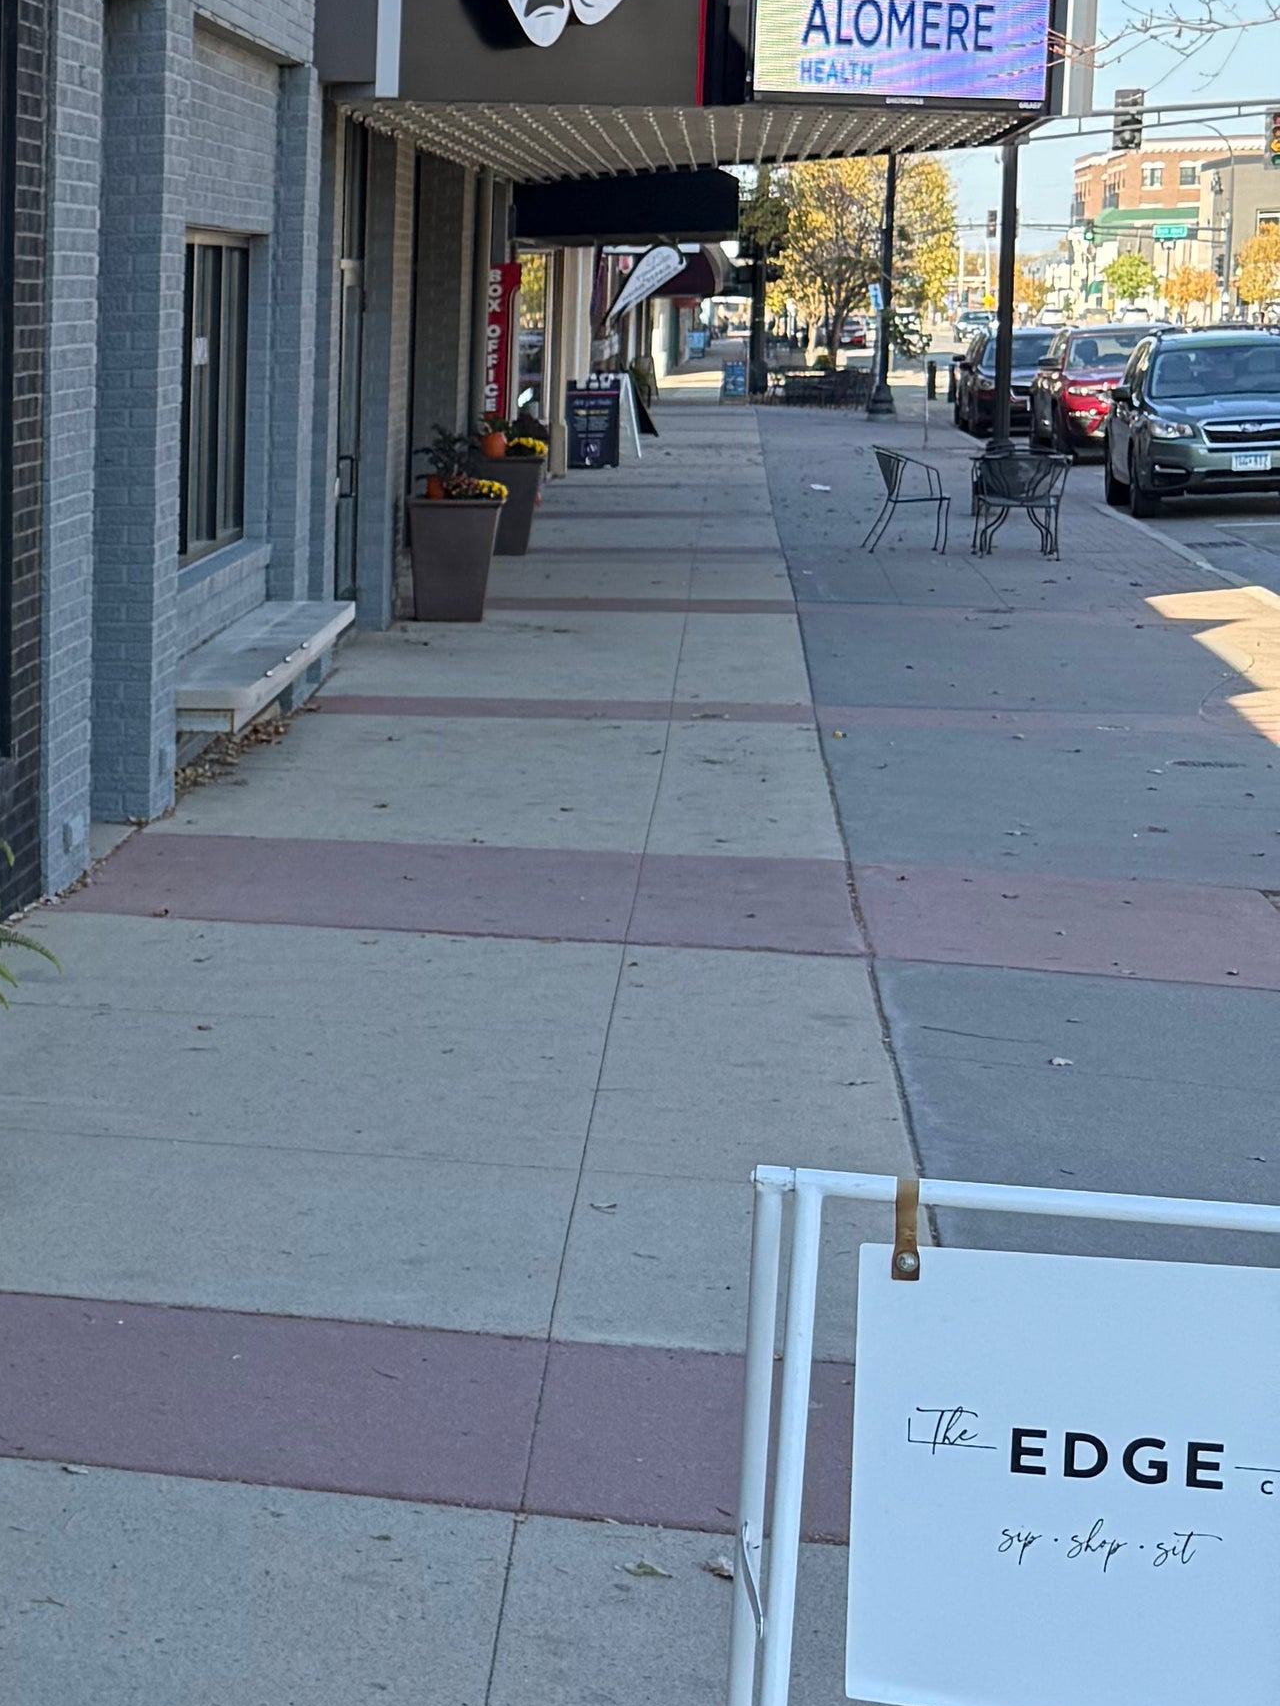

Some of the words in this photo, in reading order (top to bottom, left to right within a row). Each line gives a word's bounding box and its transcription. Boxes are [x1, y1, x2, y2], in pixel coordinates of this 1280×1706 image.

[799, 57, 873, 85] HEALTH
[488, 269, 502, 313] BOX
[485, 324, 501, 412] OFFICE
[915, 1406, 979, 1455] The
[1009, 1427, 1225, 1491] EDGE
[997, 1525, 1043, 1565] sip
[1066, 1518, 1128, 1573] shop
[1152, 1531, 1223, 1565] sit
